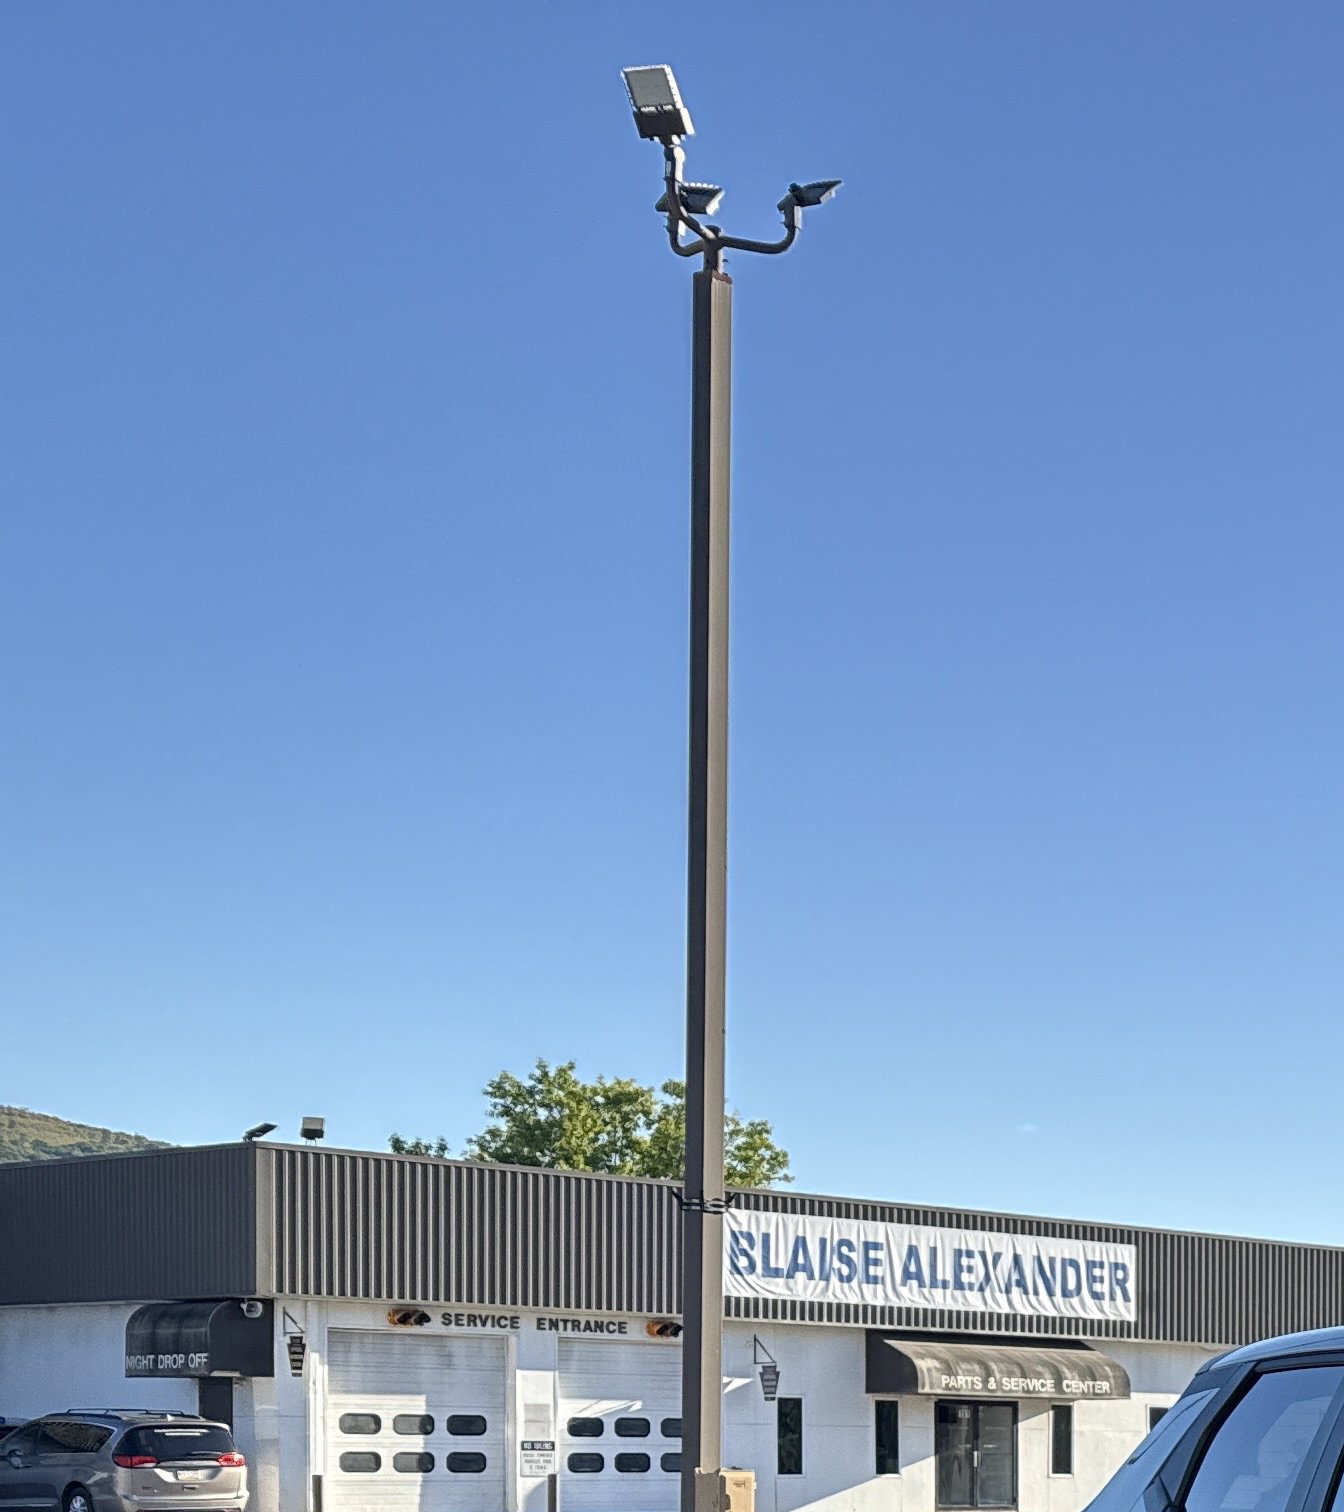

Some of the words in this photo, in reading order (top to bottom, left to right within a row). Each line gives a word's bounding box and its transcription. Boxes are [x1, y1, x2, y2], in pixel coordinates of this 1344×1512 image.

[729, 1229, 885, 1286] BLAISE
[900, 1243, 1132, 1303] ALEXANDER
[440, 1312, 521, 1330] SERVICE
[536, 1317, 628, 1335] ENTRANCE
[125, 1354, 155, 1370] NIGHT
[157, 1353, 185, 1369] DROP
[188, 1352, 209, 1368] OFF
[941, 1375, 983, 1390] PARTS
[987, 1377, 997, 1390] &
[1002, 1377, 1056, 1392] SERVICE
[1062, 1379, 1111, 1394] CENTER
